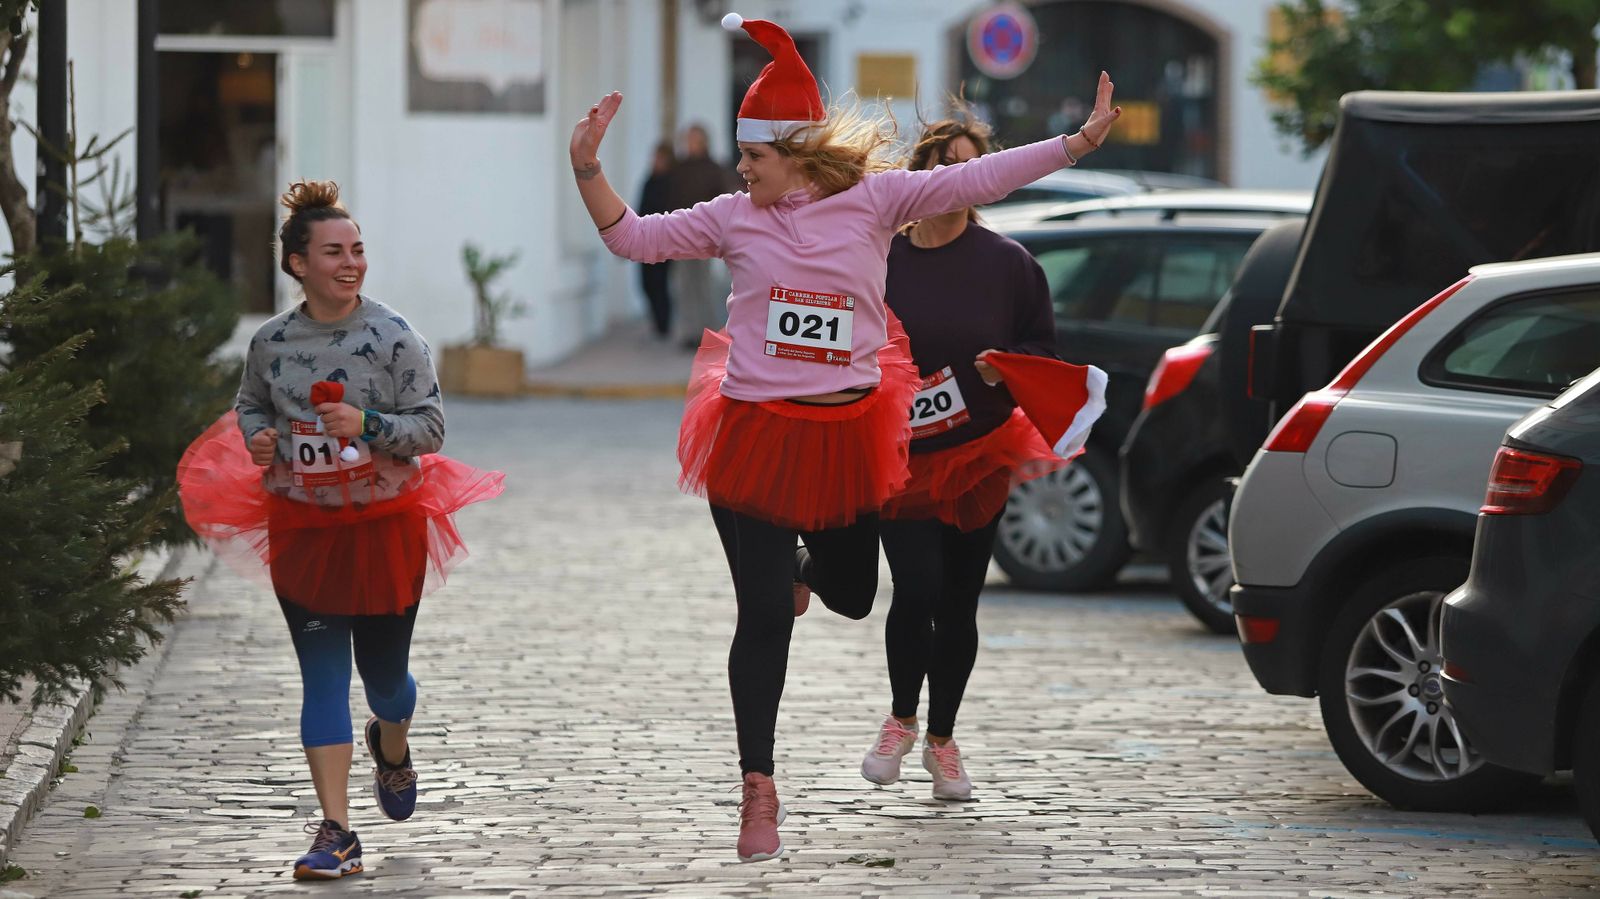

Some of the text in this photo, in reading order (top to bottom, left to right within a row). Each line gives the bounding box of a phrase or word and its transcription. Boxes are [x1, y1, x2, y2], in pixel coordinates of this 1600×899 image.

[772, 288, 788, 301] II
[788, 291, 814, 299] CARRERA
[815, 293, 838, 302] POPULAR
[779, 311, 839, 341] 021
